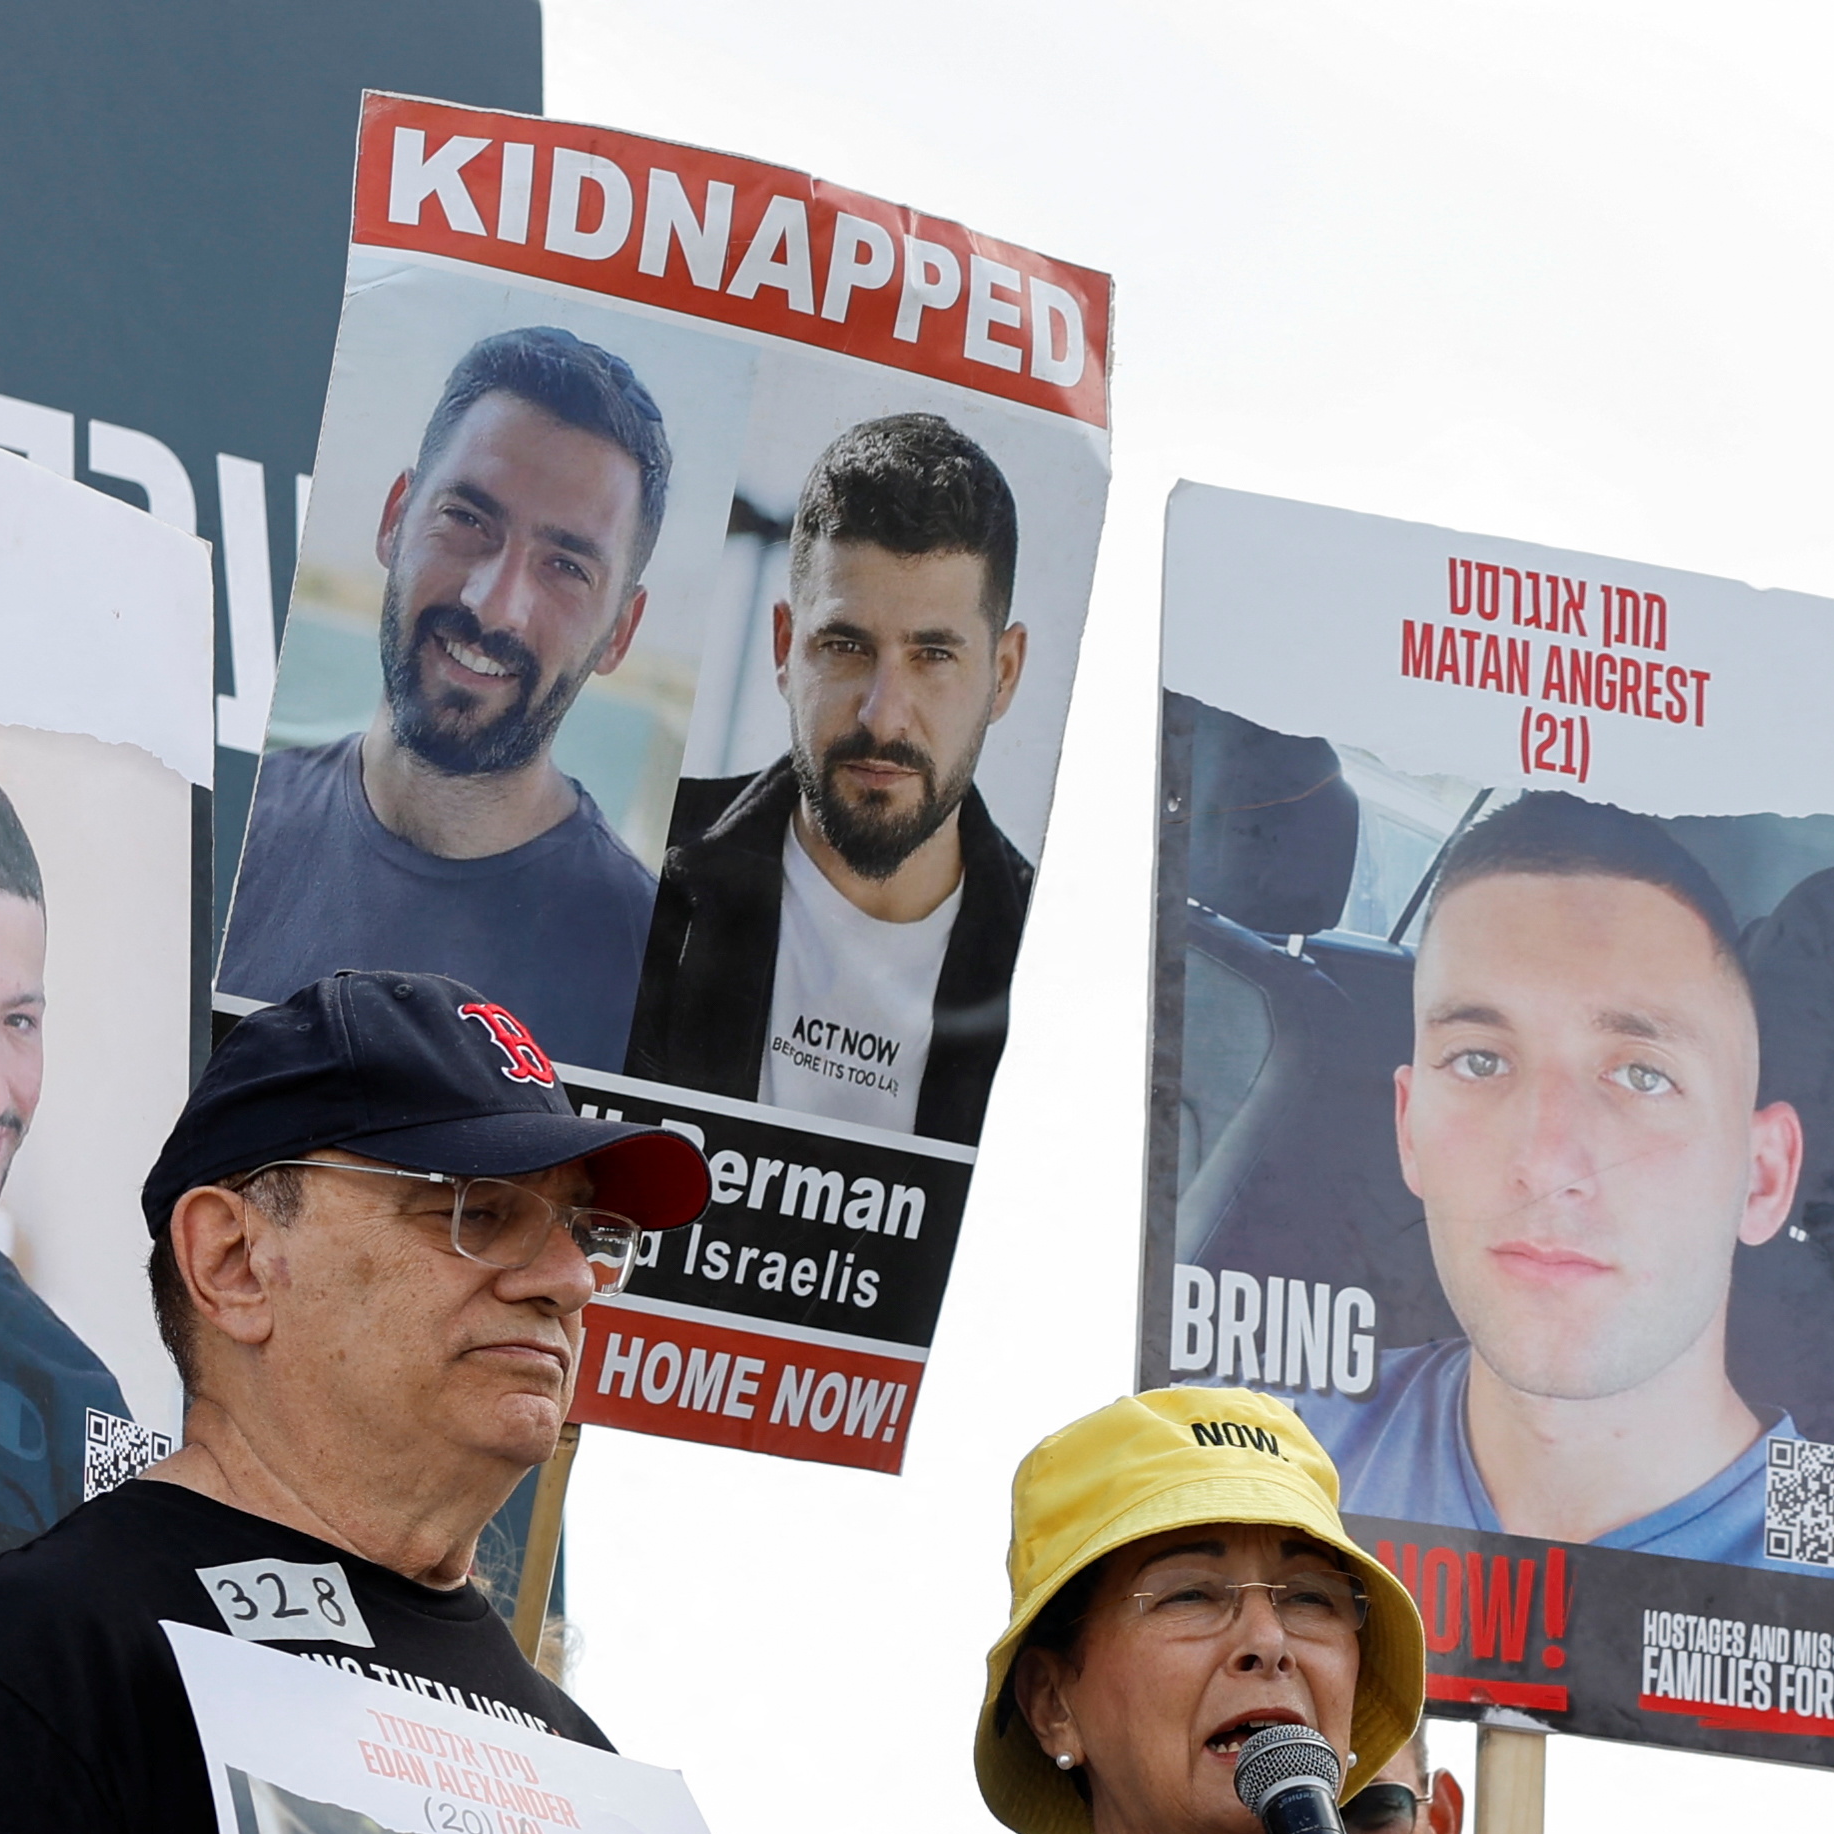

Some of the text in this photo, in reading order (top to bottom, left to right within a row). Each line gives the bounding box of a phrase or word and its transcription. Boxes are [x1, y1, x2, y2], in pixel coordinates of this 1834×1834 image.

[388, 126, 1086, 388] KIDNAPPED
[1447, 555, 1669, 652] מתן אנגרסט
[1400, 619, 1711, 728] MATAN ANGREST
[1519, 706, 1592, 784] (21)
[772, 1036, 821, 1072] BEFORE
[822, 1059, 845, 1079] ITS
[847, 1066, 876, 1087] TOO
[792, 1015, 900, 1067] ACT NOW
[661, 1118, 927, 1240] erman
[683, 1223, 881, 1309] Israelis
[1170, 1263, 1376, 1395] BRING
[597, 1332, 766, 1420] HOME
[769, 1364, 908, 1444] NOW!
[217, 1571, 347, 1627] 328
[1643, 1609, 1745, 1659] HOSTAGES
[1750, 1623, 1790, 1664] AND
[1642, 1646, 1771, 1712] FAMILIES
[358, 1739, 582, 1830] EDAN ALEXANDER
